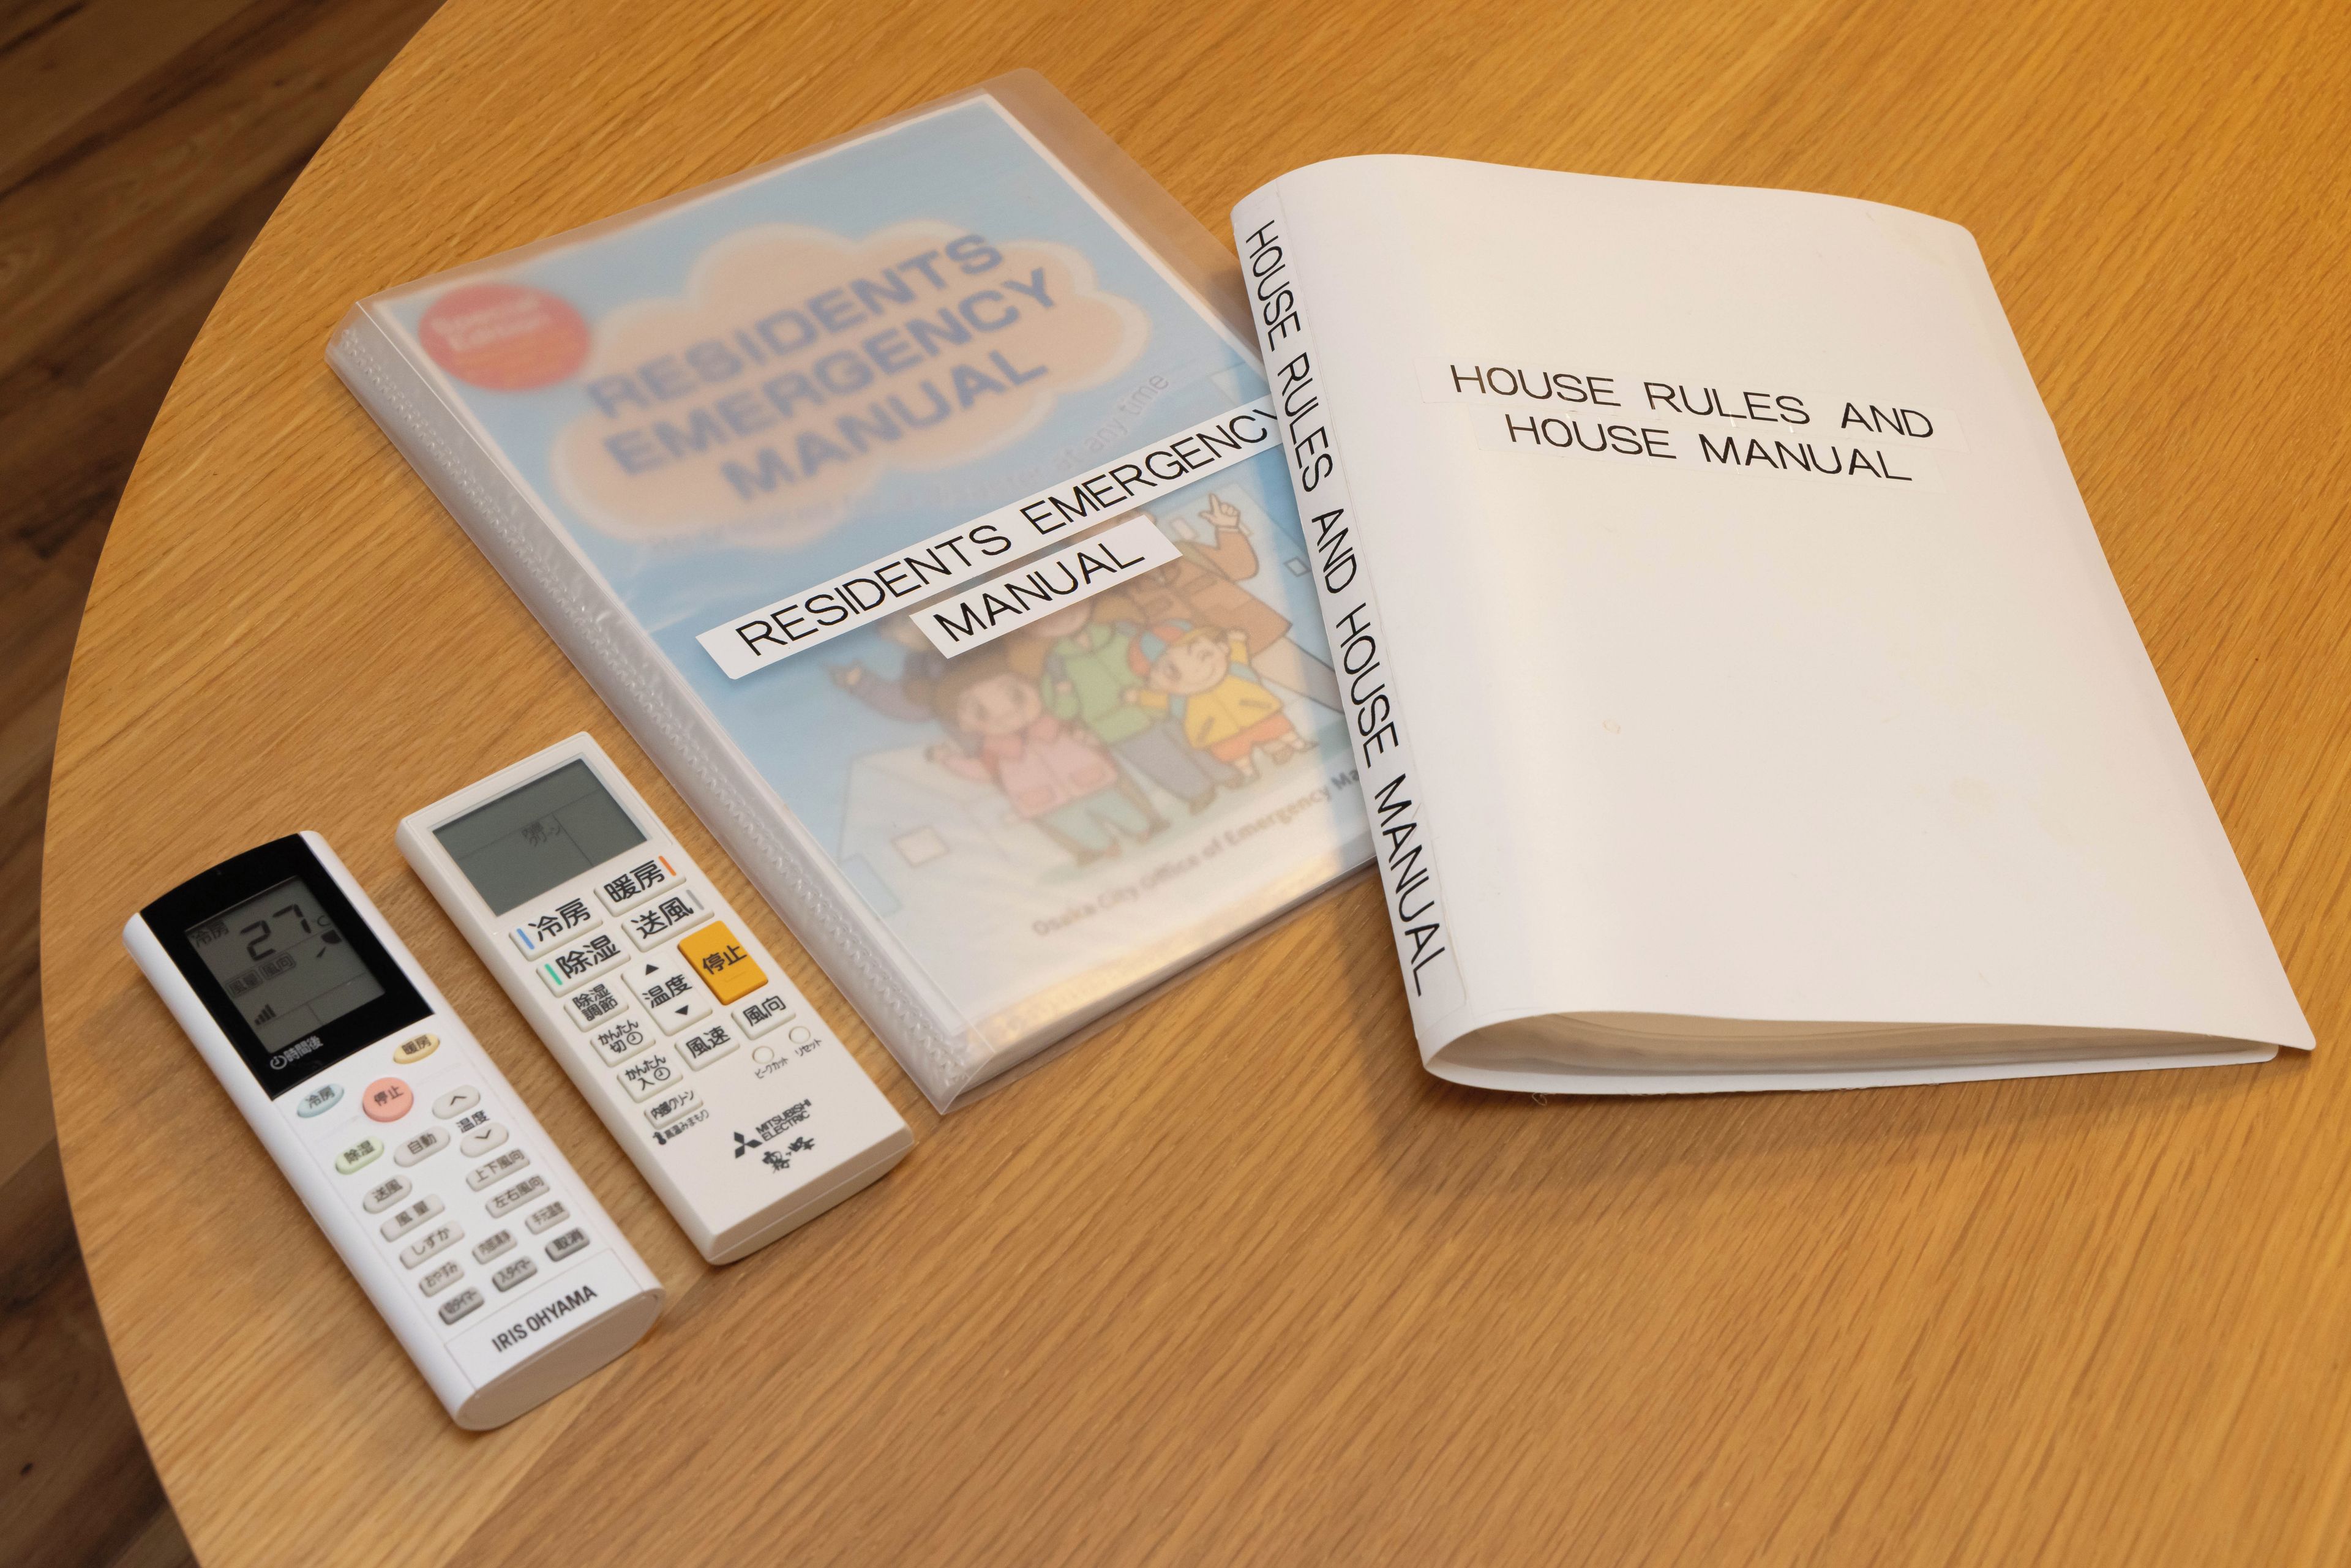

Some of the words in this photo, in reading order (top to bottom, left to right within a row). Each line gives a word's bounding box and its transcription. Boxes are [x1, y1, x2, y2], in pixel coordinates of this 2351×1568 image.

[587, 233, 1005, 419] RESIDENTS
[602, 266, 1057, 476] EMERGENCY
[1120, 372, 1170, 416] time
[1450, 364, 1622, 407] HOUSE
[1644, 381, 1810, 425] RULES
[1841, 402, 1934, 438] AND
[721, 348, 1049, 498] MANUAL
[1504, 413, 1677, 459] HOUSE
[1698, 433, 1913, 481] MANUAL
[735, 525, 1011, 657] RESIDENTS
[932, 543, 1146, 643] MANUAL
[1246, 220, 1301, 352] HOUSE
[1278, 353, 1333, 492] RULES
[1312, 508, 1357, 594] AND
[1336, 602, 1398, 768] HOUSE
[1374, 773, 1445, 997] MANUAL
[604, 860, 666, 903] 暖房
[528, 898, 591, 942] 冷房
[631, 897, 694, 939] 送風
[555, 934, 621, 979] 除湿
[702, 945, 748, 975] 停止
[572, 983, 611, 1010] 除湿
[642, 973, 692, 1009] 温度
[582, 995, 619, 1021] 調節
[743, 996, 787, 1026] 風向
[402, 1035, 432, 1055] 暖房
[598, 1019, 639, 1045] かんたん
[686, 1026, 731, 1059] 風速
[795, 1038, 822, 1057] リセット
[625, 1054, 666, 1081] かんたん
[306, 1086, 336, 1109] 冷房
[373, 1085, 403, 1106] 停止
[651, 1090, 695, 1120] 内部クリーン
[457, 1110, 490, 1133] 温度
[756, 1098, 812, 1134] MITSUBISHI
[762, 1111, 810, 1141] ELECTRIC
[408, 1133, 437, 1155] 自動
[476, 1149, 525, 1182] 上下風向
[372, 1179, 403, 1202] 送風
[492, 1176, 544, 1208] 左右風向
[411, 1227, 450, 1256] しずか
[491, 1324, 529, 1352] IRIS
[528, 1285, 598, 1332] OHYAMA
